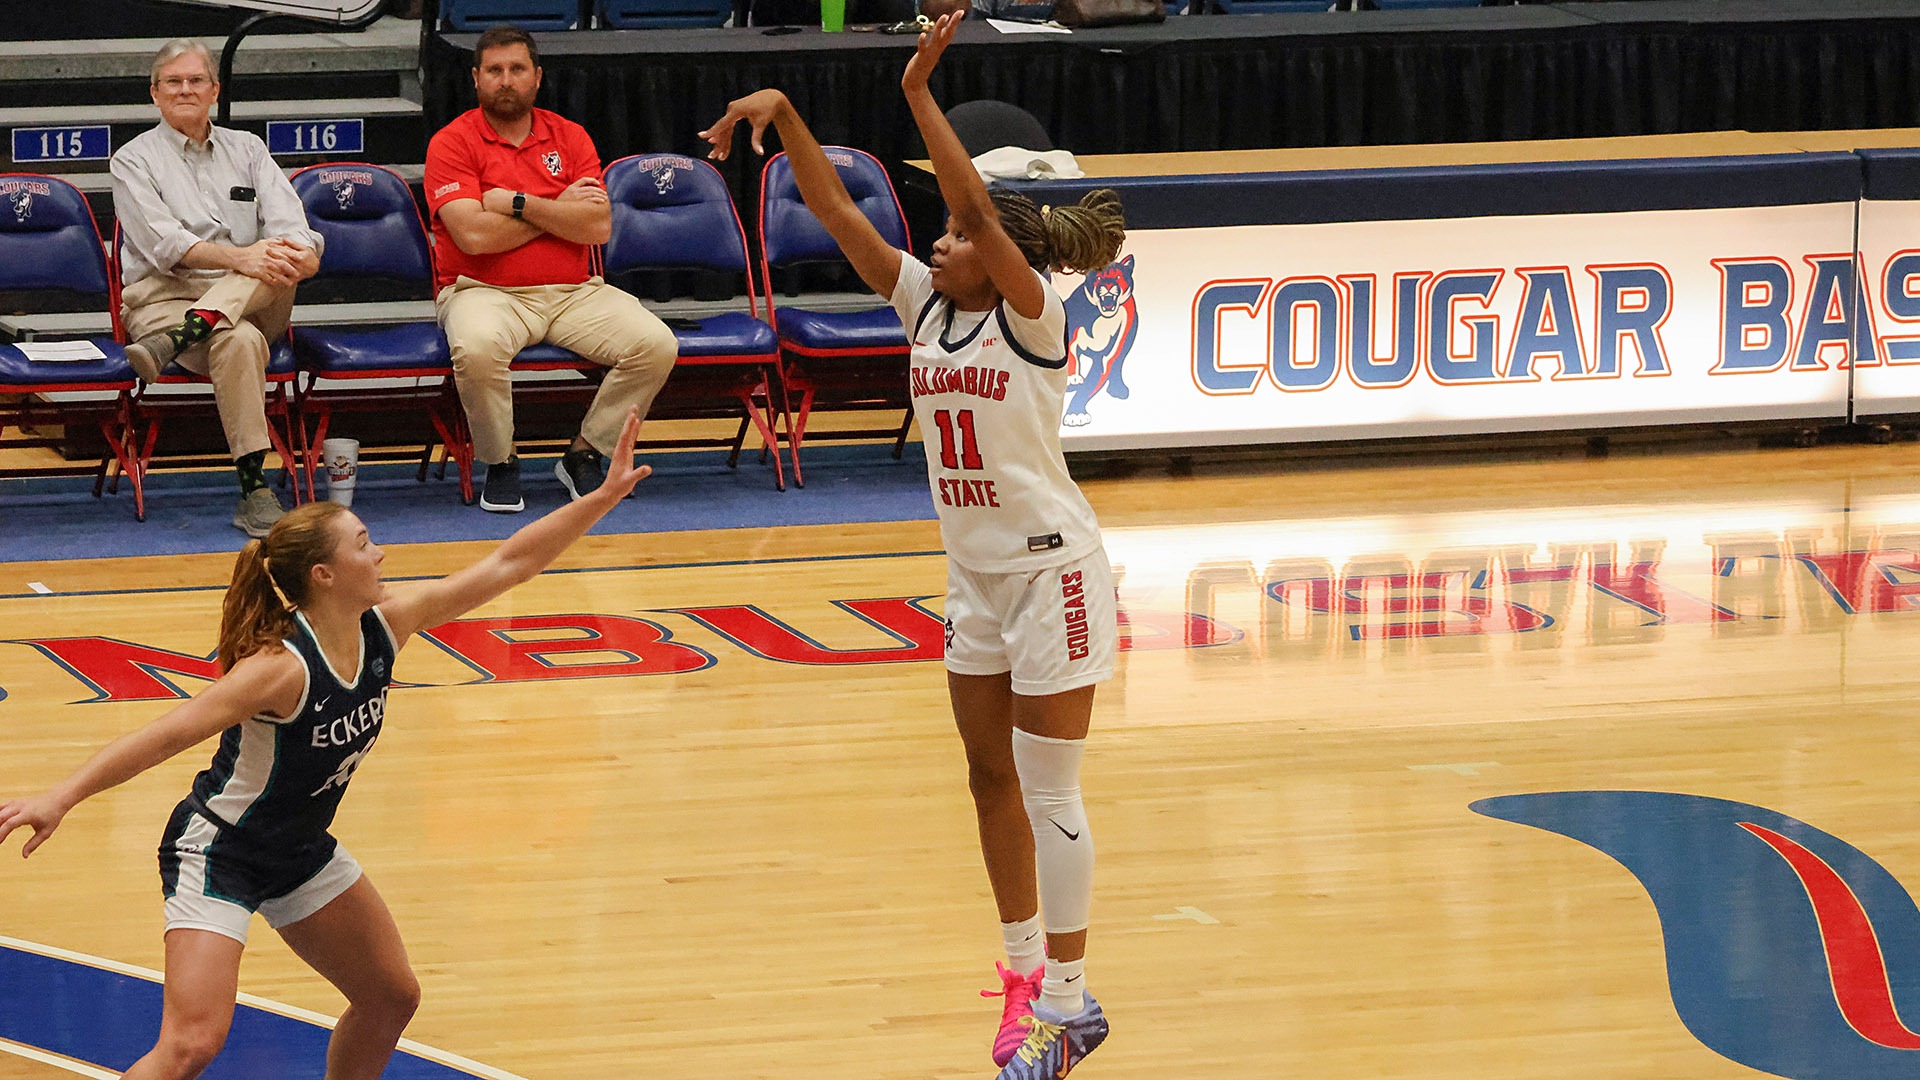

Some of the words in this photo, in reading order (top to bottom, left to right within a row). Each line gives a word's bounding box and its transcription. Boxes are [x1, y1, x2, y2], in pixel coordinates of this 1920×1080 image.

[40, 131, 83, 157] 115
[294, 124, 337, 150] 116
[1191, 263, 1673, 397] COUGAR
[911, 365, 1010, 402] OLUMBUS
[933, 409, 985, 471] 11
[938, 477, 1001, 508] STATE
[1061, 569, 1089, 662] COUGARS
